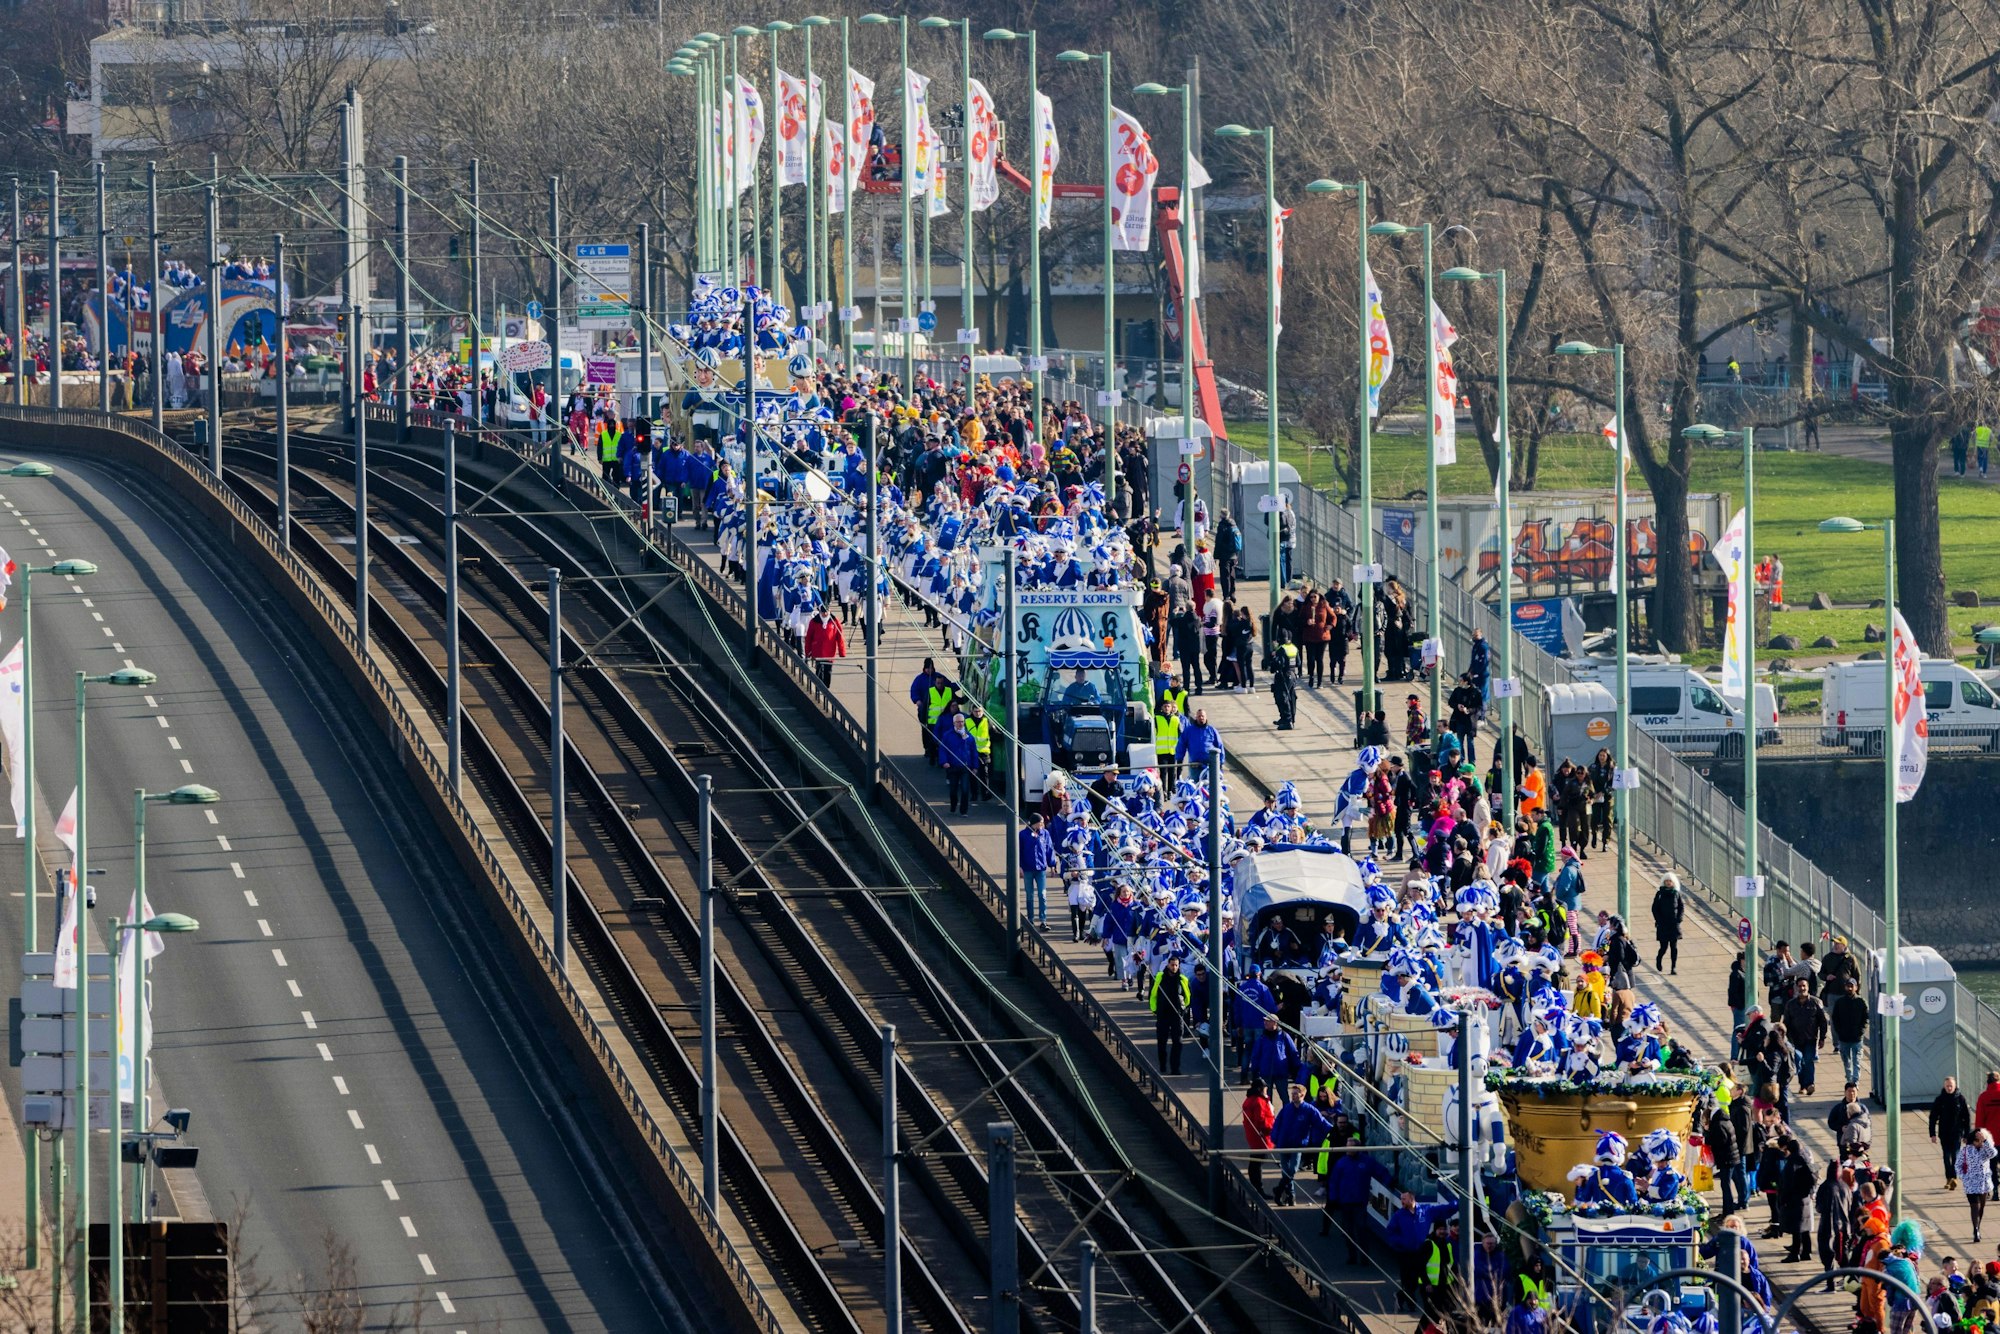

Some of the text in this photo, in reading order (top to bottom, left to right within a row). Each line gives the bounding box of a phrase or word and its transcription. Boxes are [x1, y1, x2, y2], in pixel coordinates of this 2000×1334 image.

[1270, 499, 1278, 507] 18
[1366, 568, 1375, 577] 19
[1020, 593, 1123, 604] RESERVE KORPS
[1502, 682, 1513, 692] 21
[1644, 716, 1669, 726] WDR
[1926, 712, 1940, 722] DR
[1899, 763, 1919, 773] eval
[1745, 881, 1757, 891] 23
[1924, 994, 1942, 1003] EGN
